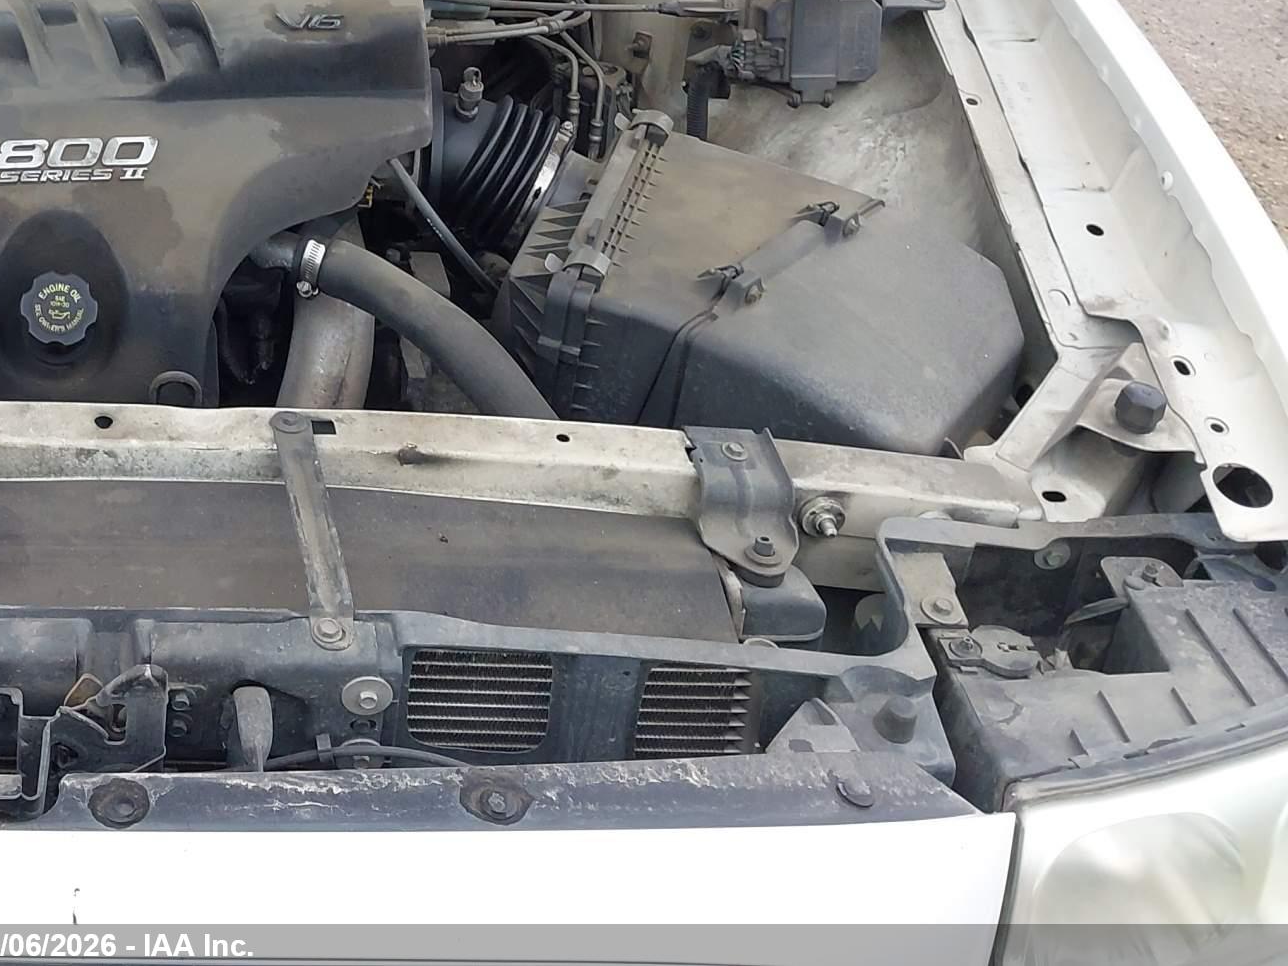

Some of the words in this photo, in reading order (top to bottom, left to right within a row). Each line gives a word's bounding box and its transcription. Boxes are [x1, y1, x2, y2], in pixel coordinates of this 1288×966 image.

[274, 13, 344, 30] V6
[38, 282, 71, 300] ENGINE
[69, 289, 82, 304] OIL
